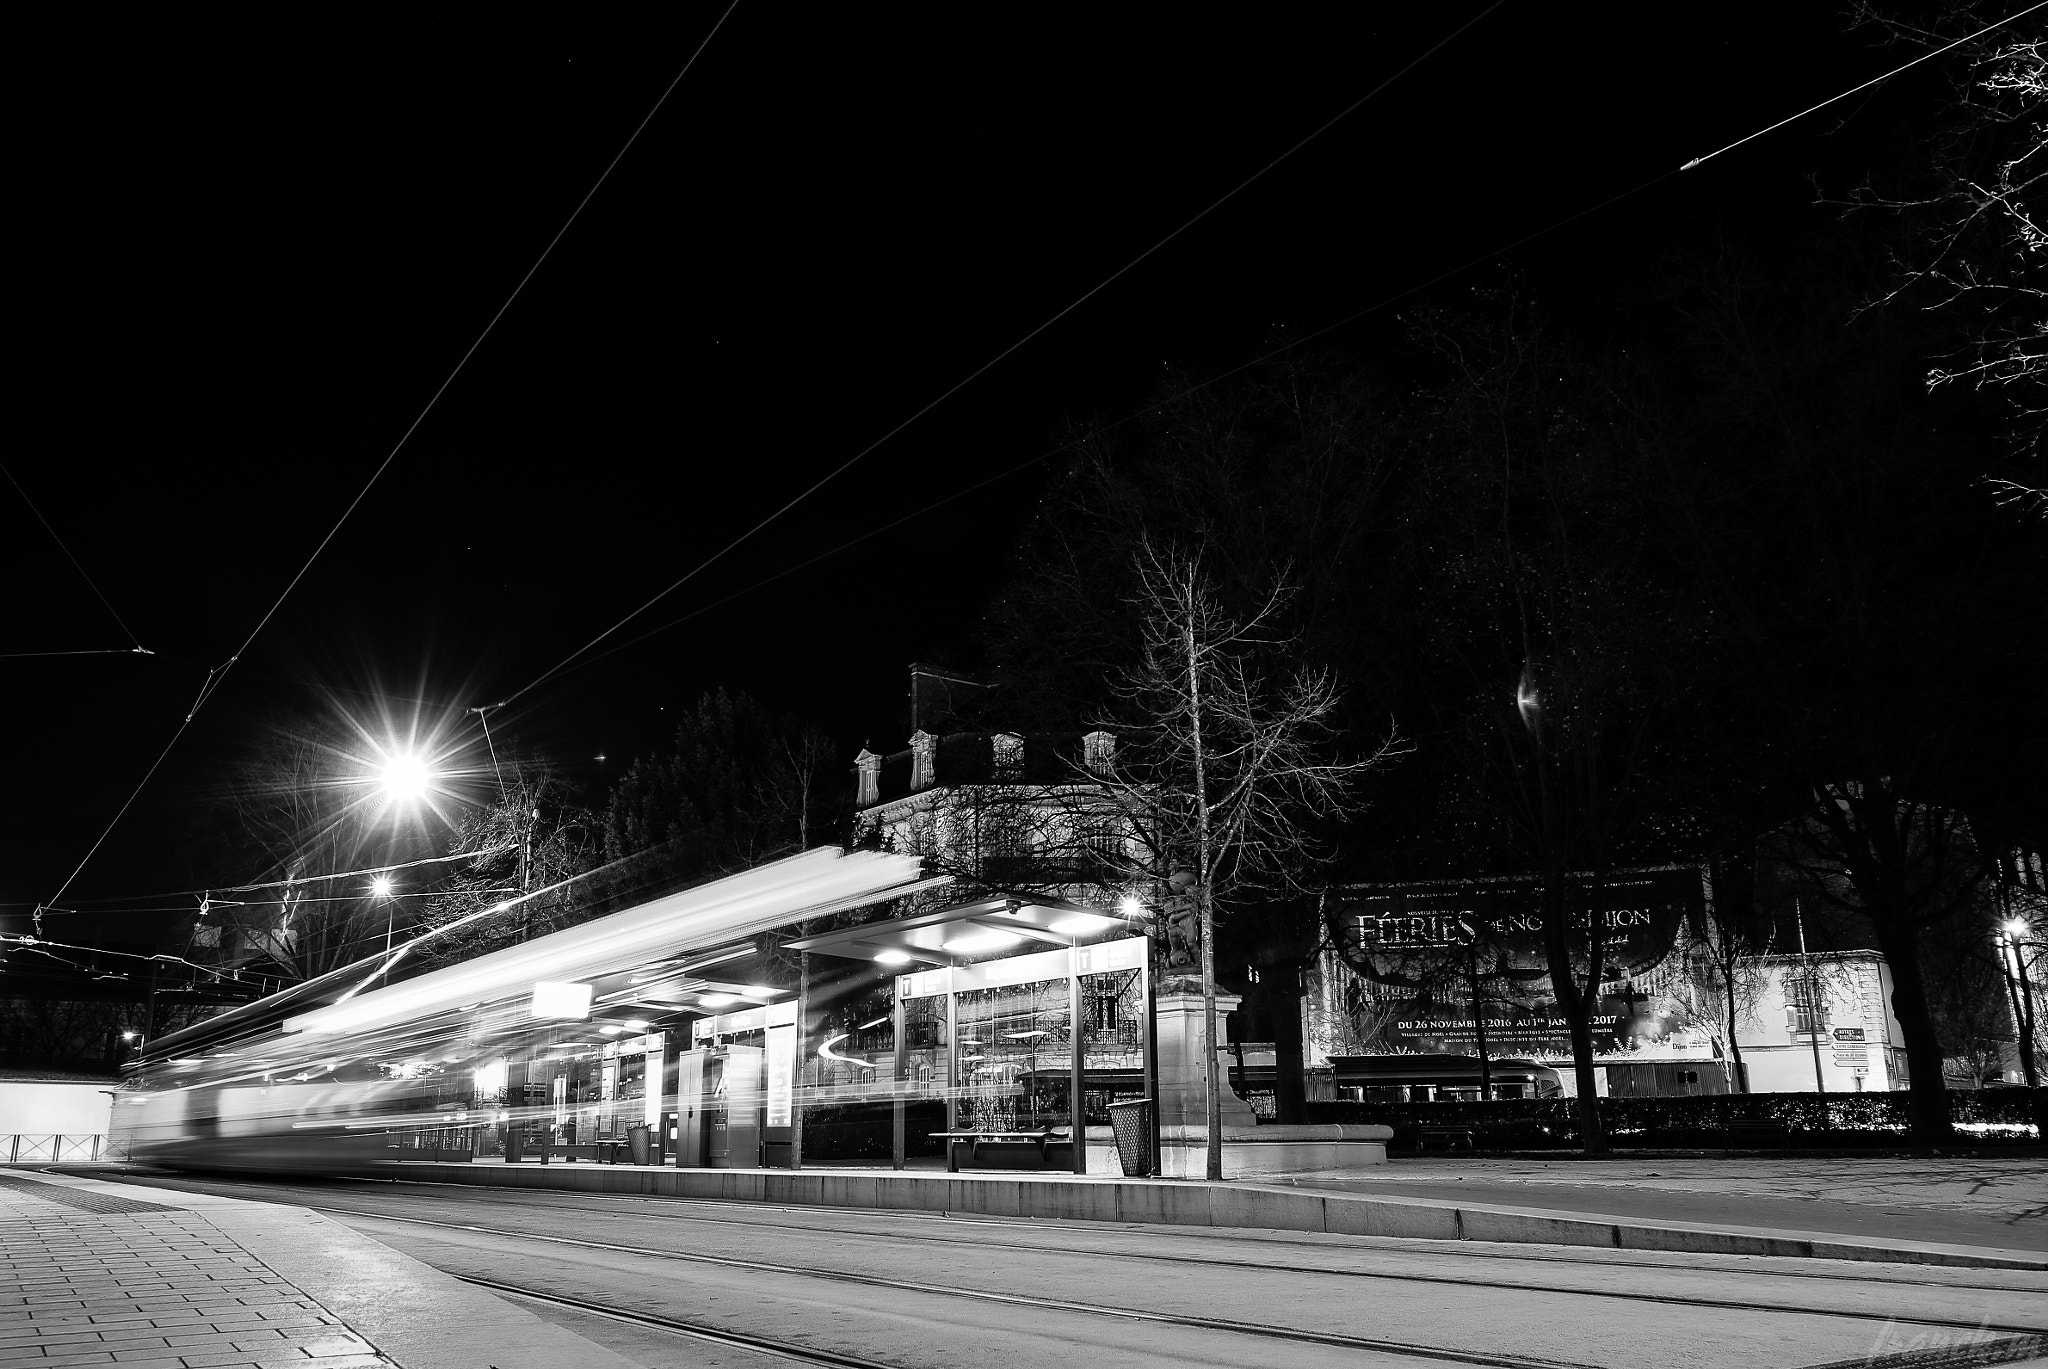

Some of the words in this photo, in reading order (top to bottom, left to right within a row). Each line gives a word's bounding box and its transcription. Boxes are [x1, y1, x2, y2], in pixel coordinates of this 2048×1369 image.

[1355, 910, 1476, 949] FÉERIES
[1508, 914, 1543, 931] NO
[1398, 1021, 1413, 1029] DU
[1415, 1020, 1428, 1029] 26
[1487, 1018, 1512, 1028] 2016
[1516, 1018, 1531, 1027] AU
[1592, 1015, 1618, 1025] 2017
[1672, 1042, 1687, 1051] Dijon
